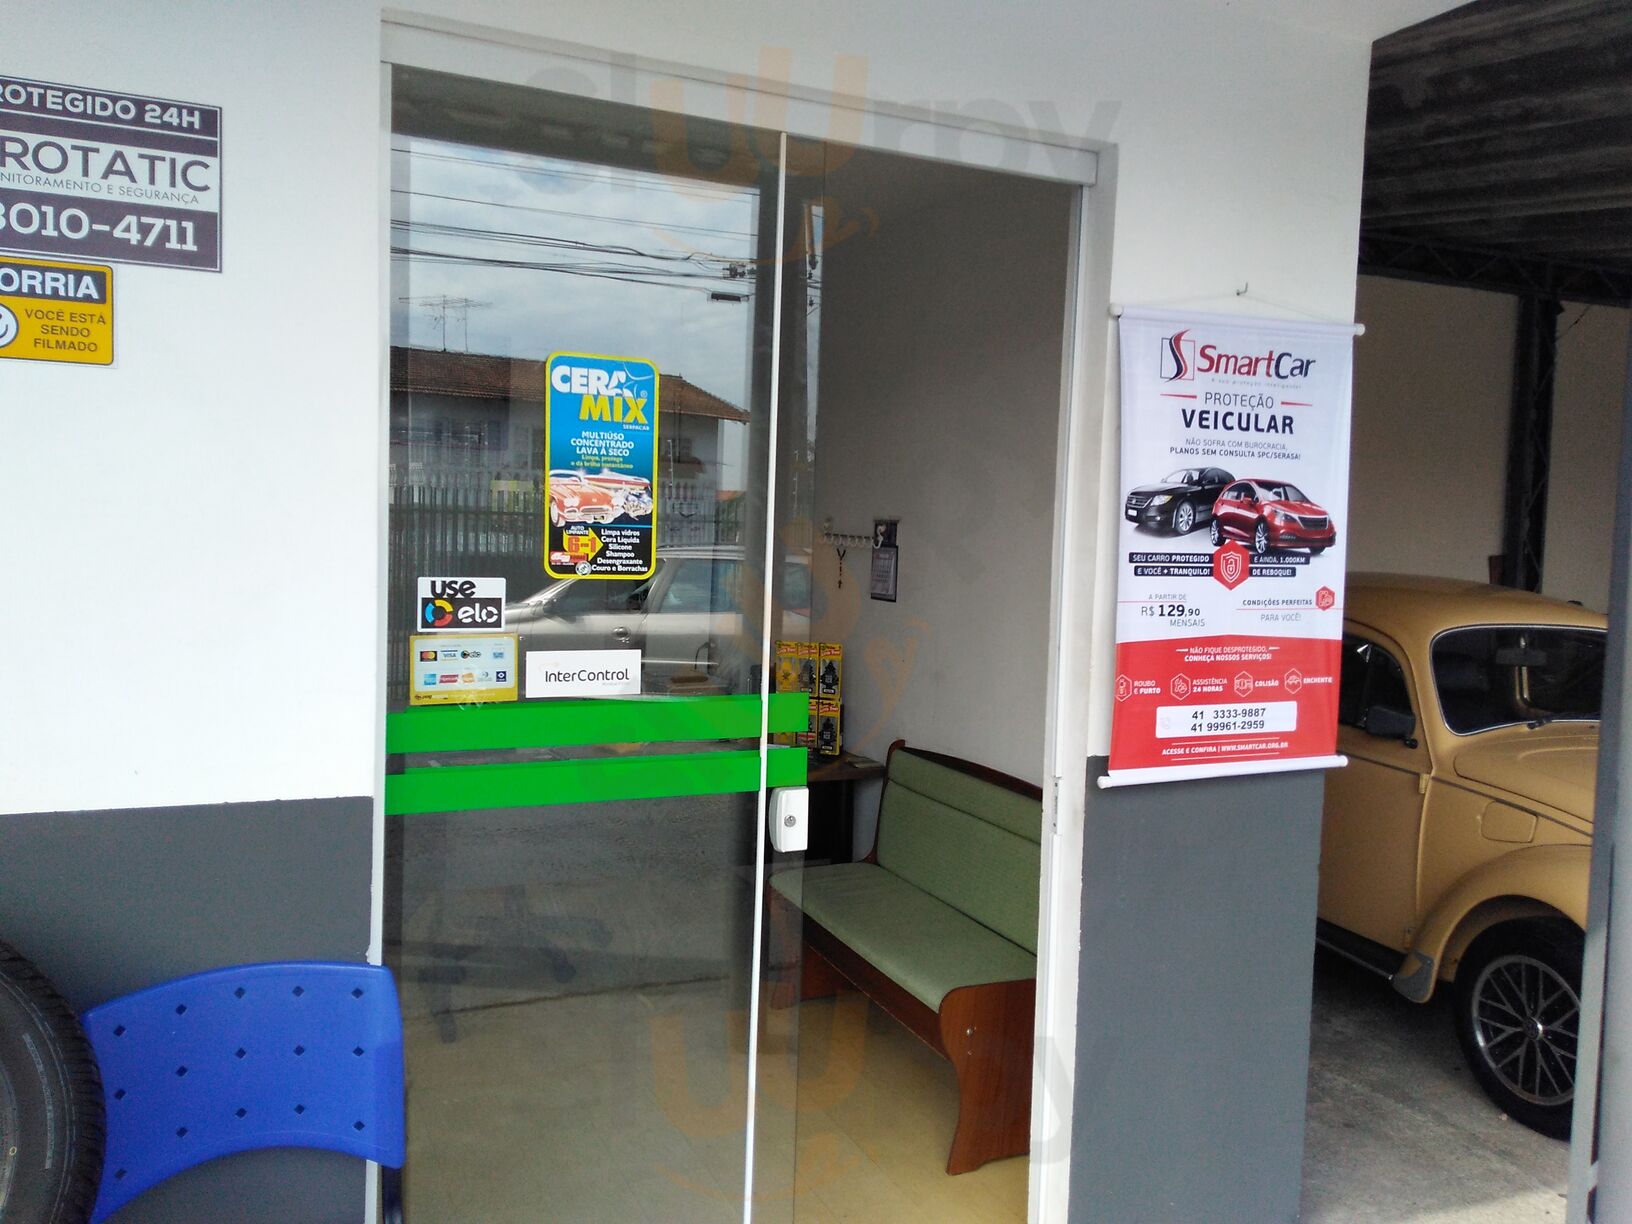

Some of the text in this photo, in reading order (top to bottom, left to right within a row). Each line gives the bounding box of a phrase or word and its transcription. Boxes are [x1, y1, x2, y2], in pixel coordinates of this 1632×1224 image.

[0, 83, 200, 130] OTEGIDO 24H
[106, 183, 114, 195] E
[118, 184, 200, 206] SEGURANÇA
[0, 201, 198, 252] 010-4711
[24, 308, 65, 322] VOCÊ
[40, 324, 90, 338] SENDO
[33, 338, 98, 352] FILMADO
[1197, 344, 1316, 380] SmartCar
[551, 364, 634, 398] CERA
[1204, 391, 1274, 410] PROTEÇÃO
[1182, 408, 1294, 434] VEICULAR
[570, 438, 634, 450] CONCENTRADO
[1186, 437, 1201, 446] NÃO
[1203, 439, 1225, 447] SOFRA
[1228, 440, 1243, 448] COM
[576, 446, 598, 455] LAVA
[608, 448, 630, 457] SECO
[1170, 446, 1199, 455] PLANOS
[1202, 448, 1217, 456] SEM
[1219, 450, 1255, 458] CONSULTA
[601, 528, 620, 537] Limpa
[597, 558, 643, 566] Desengraxante
[1171, 555, 1210, 563] PROTEGIDO
[592, 564, 611, 572] Couro
[1144, 566, 1162, 575] VOCÊ
[1170, 568, 1210, 576] TRANQUILO!
[1242, 598, 1280, 608] CONDIÇÕES
[1141, 604, 1200, 618] R$ 129,90
[1170, 618, 1205, 627] MENSAIS
[1190, 646, 1202, 654] NÃO
[1184, 654, 1214, 662] CONHEÇA
[545, 668, 630, 683] InterControl
[1303, 676, 1333, 684] ENCHENTE
[1192, 678, 1227, 686] ASSISTÊNCIA
[1254, 679, 1279, 687] COLISÃO
[1192, 707, 1266, 720] 41 3333-9887
[1190, 720, 1264, 732] 41 99961-2959
[1191, 746, 1217, 754] CONFIRA
[1221, 742, 1288, 752] WWW.SMARTCAR.ORG.BR
